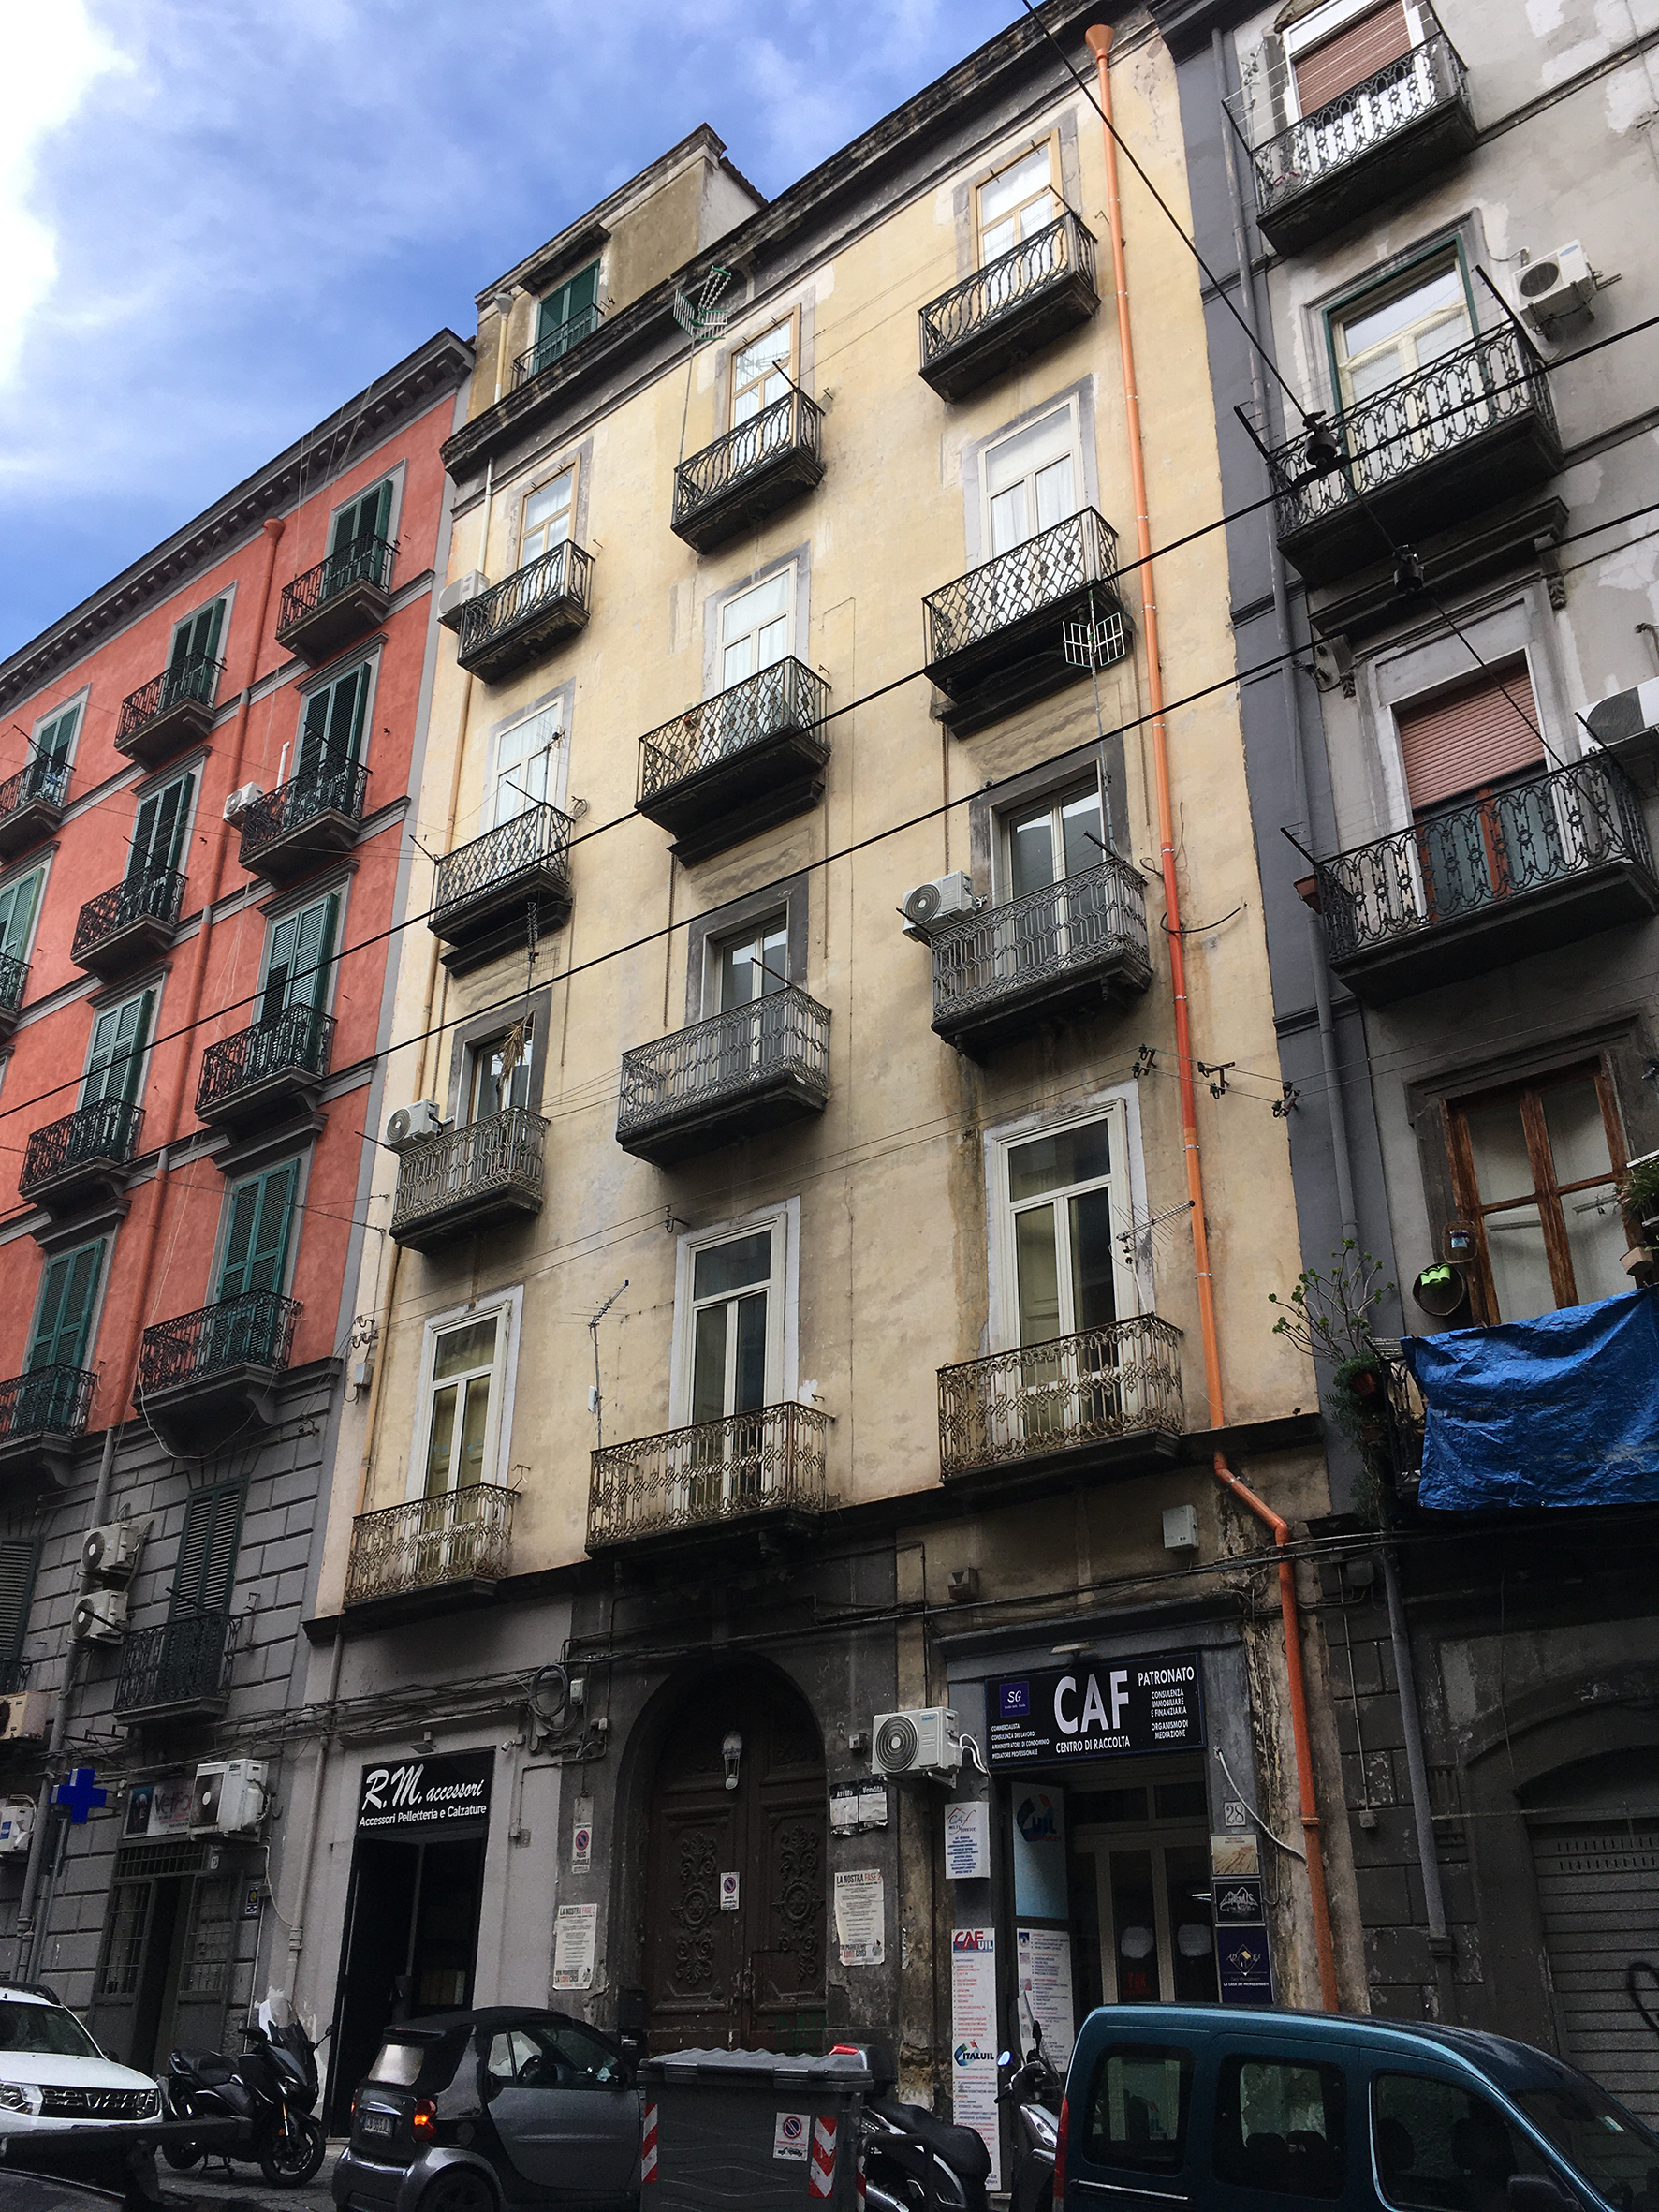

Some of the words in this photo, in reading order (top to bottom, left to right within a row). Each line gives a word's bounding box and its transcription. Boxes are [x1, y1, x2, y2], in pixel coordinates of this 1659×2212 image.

[1138, 1666, 1195, 1687] PATRONATO
[1006, 1689, 1022, 1703] SG
[1151, 1688, 1184, 1700] CONSULENZA
[1053, 1670, 1129, 1735] CAF
[1152, 1697, 1184, 1708] IMMOBILIARE
[1151, 1709, 1154, 1718] E
[1154, 1706, 1187, 1717] FINANZIARIA
[1151, 1721, 1182, 1732] ORGANISMO
[1182, 1719, 1189, 1728] DI
[1154, 1729, 1186, 1740] MEDIAZIONE
[1055, 1740, 1083, 1754] CENTRO
[1084, 1739, 1093, 1750] DI
[1094, 1735, 1131, 1750] RACCOLTA
[425, 1779, 485, 1802] accessori
[862, 1785, 883, 1794] Vendita
[359, 1813, 396, 1828] Accessori
[397, 1809, 438, 1823] Pelletteria
[439, 1810, 446, 1819] e
[447, 1804, 487, 1818] Calzature
[1226, 1804, 1244, 1824] 28
[836, 1875, 843, 1884] LA
[844, 1874, 864, 1884] NOSTRA
[864, 1872, 877, 1882] FASE
[559, 1908, 565, 1916] LA
[955, 1930, 983, 1950] CAF
[977, 1940, 993, 1950] UIL
[962, 2052, 995, 2061] ITALUIL
